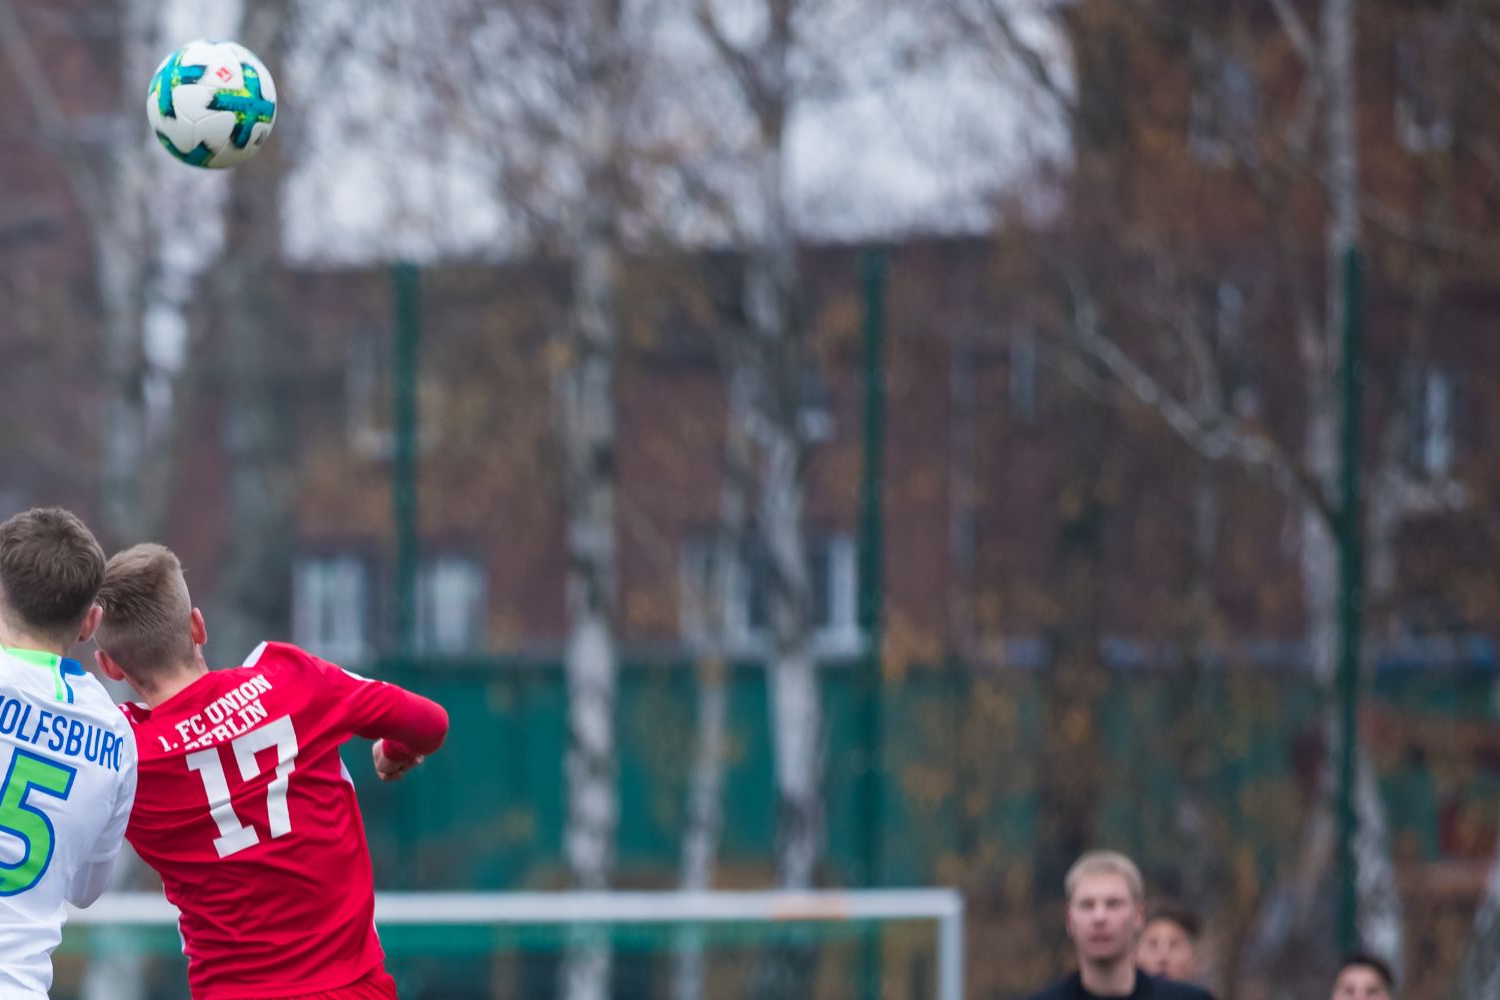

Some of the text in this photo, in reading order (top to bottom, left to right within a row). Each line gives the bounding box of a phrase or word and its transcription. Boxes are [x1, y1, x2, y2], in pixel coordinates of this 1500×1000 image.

[158, 674, 273, 752] 1. FC UNION
[185, 713, 299, 859] 17
